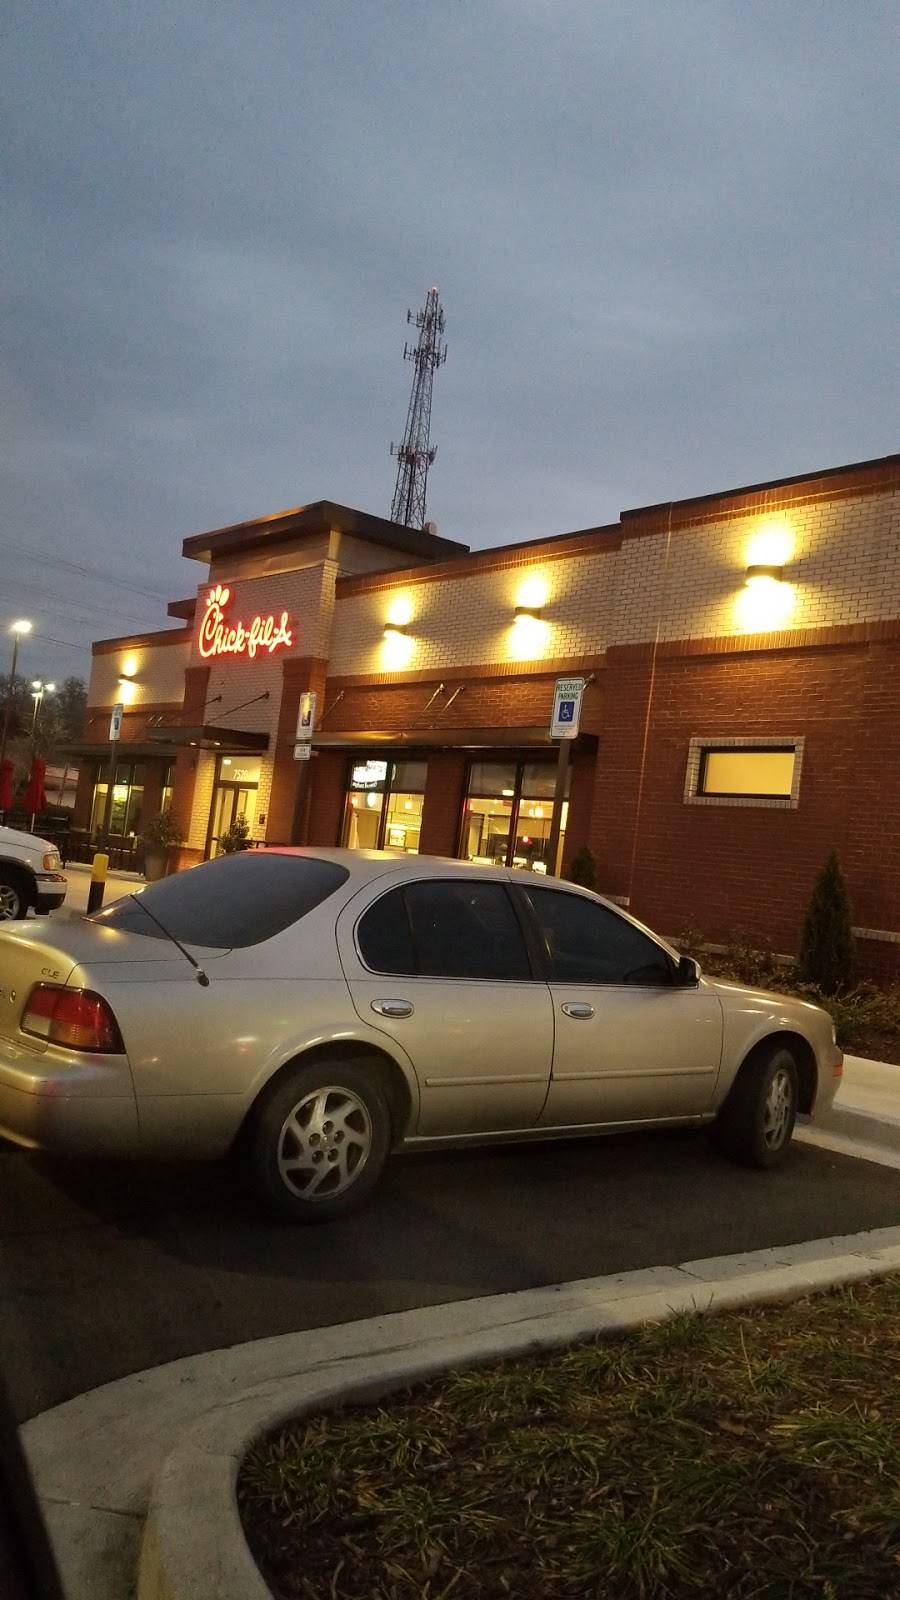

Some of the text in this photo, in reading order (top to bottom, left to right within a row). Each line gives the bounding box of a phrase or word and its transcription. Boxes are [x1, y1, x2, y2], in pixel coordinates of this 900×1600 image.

[198, 602, 292, 658] Chick-fil-A
[556, 683, 583, 692] RESERVED
[558, 692, 579, 700] PARKING
